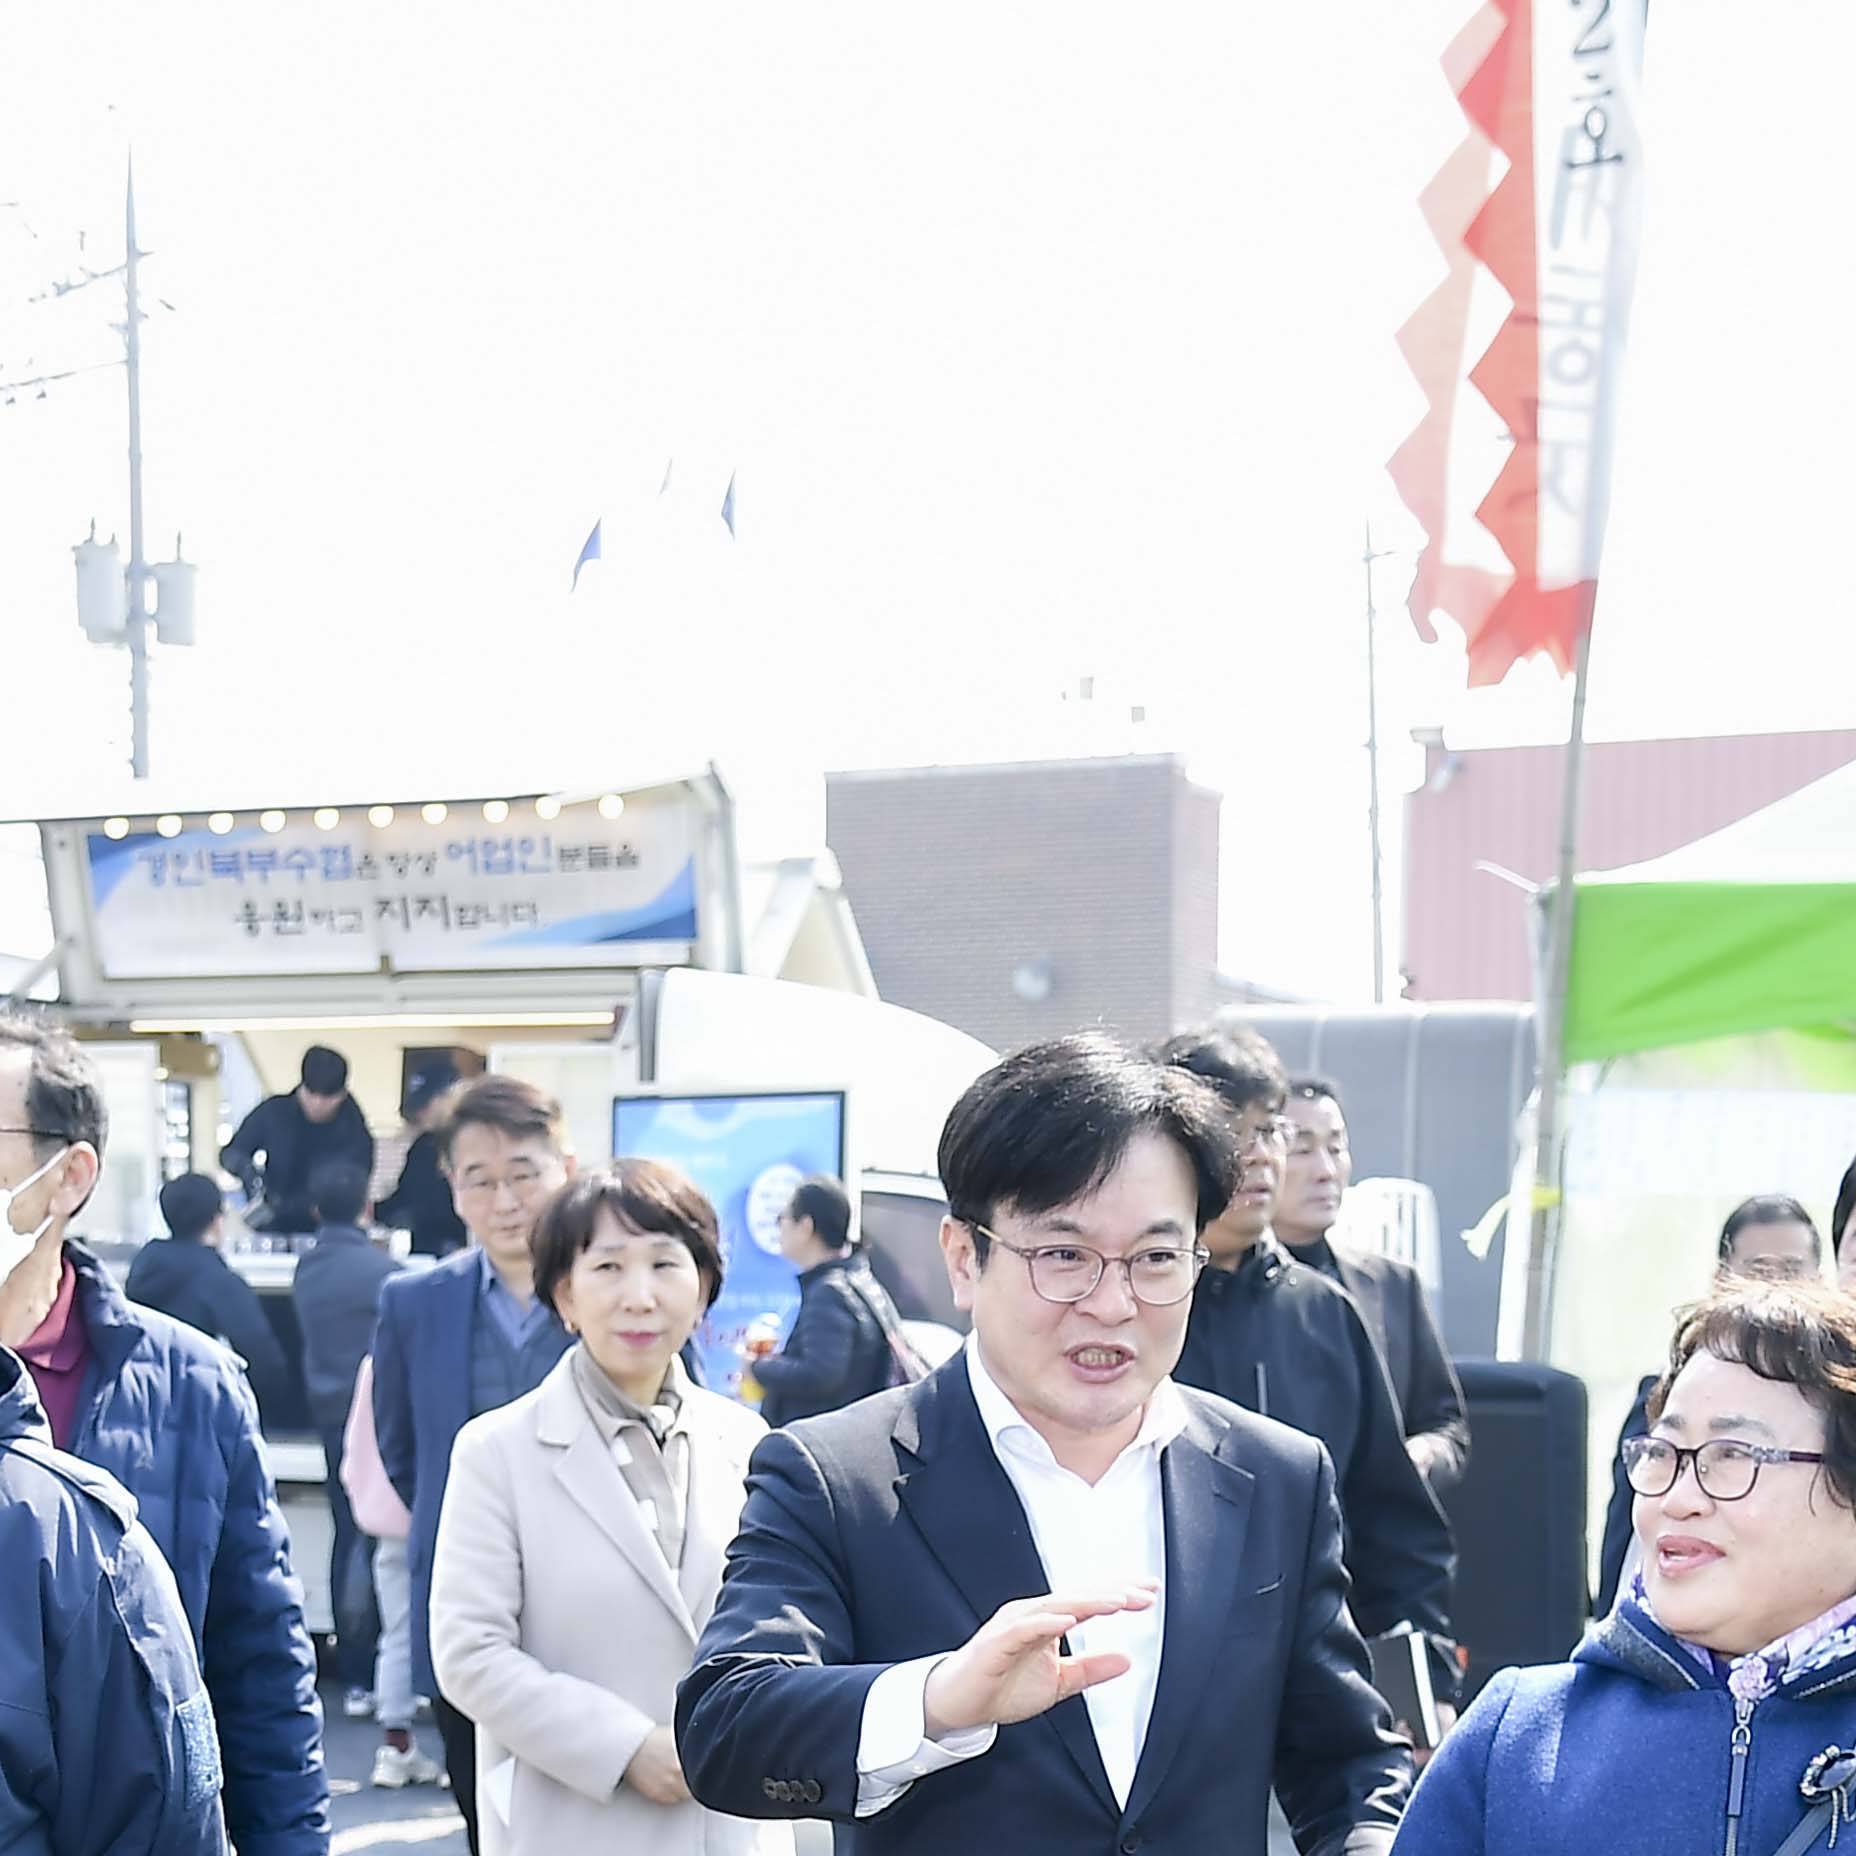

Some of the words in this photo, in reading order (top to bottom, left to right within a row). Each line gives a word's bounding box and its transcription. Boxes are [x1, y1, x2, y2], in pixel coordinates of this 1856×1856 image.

[137, 843, 378, 887] 경인북부수협은
[446, 834, 640, 876] 어업인분들을
[233, 897, 364, 938] 응원하고
